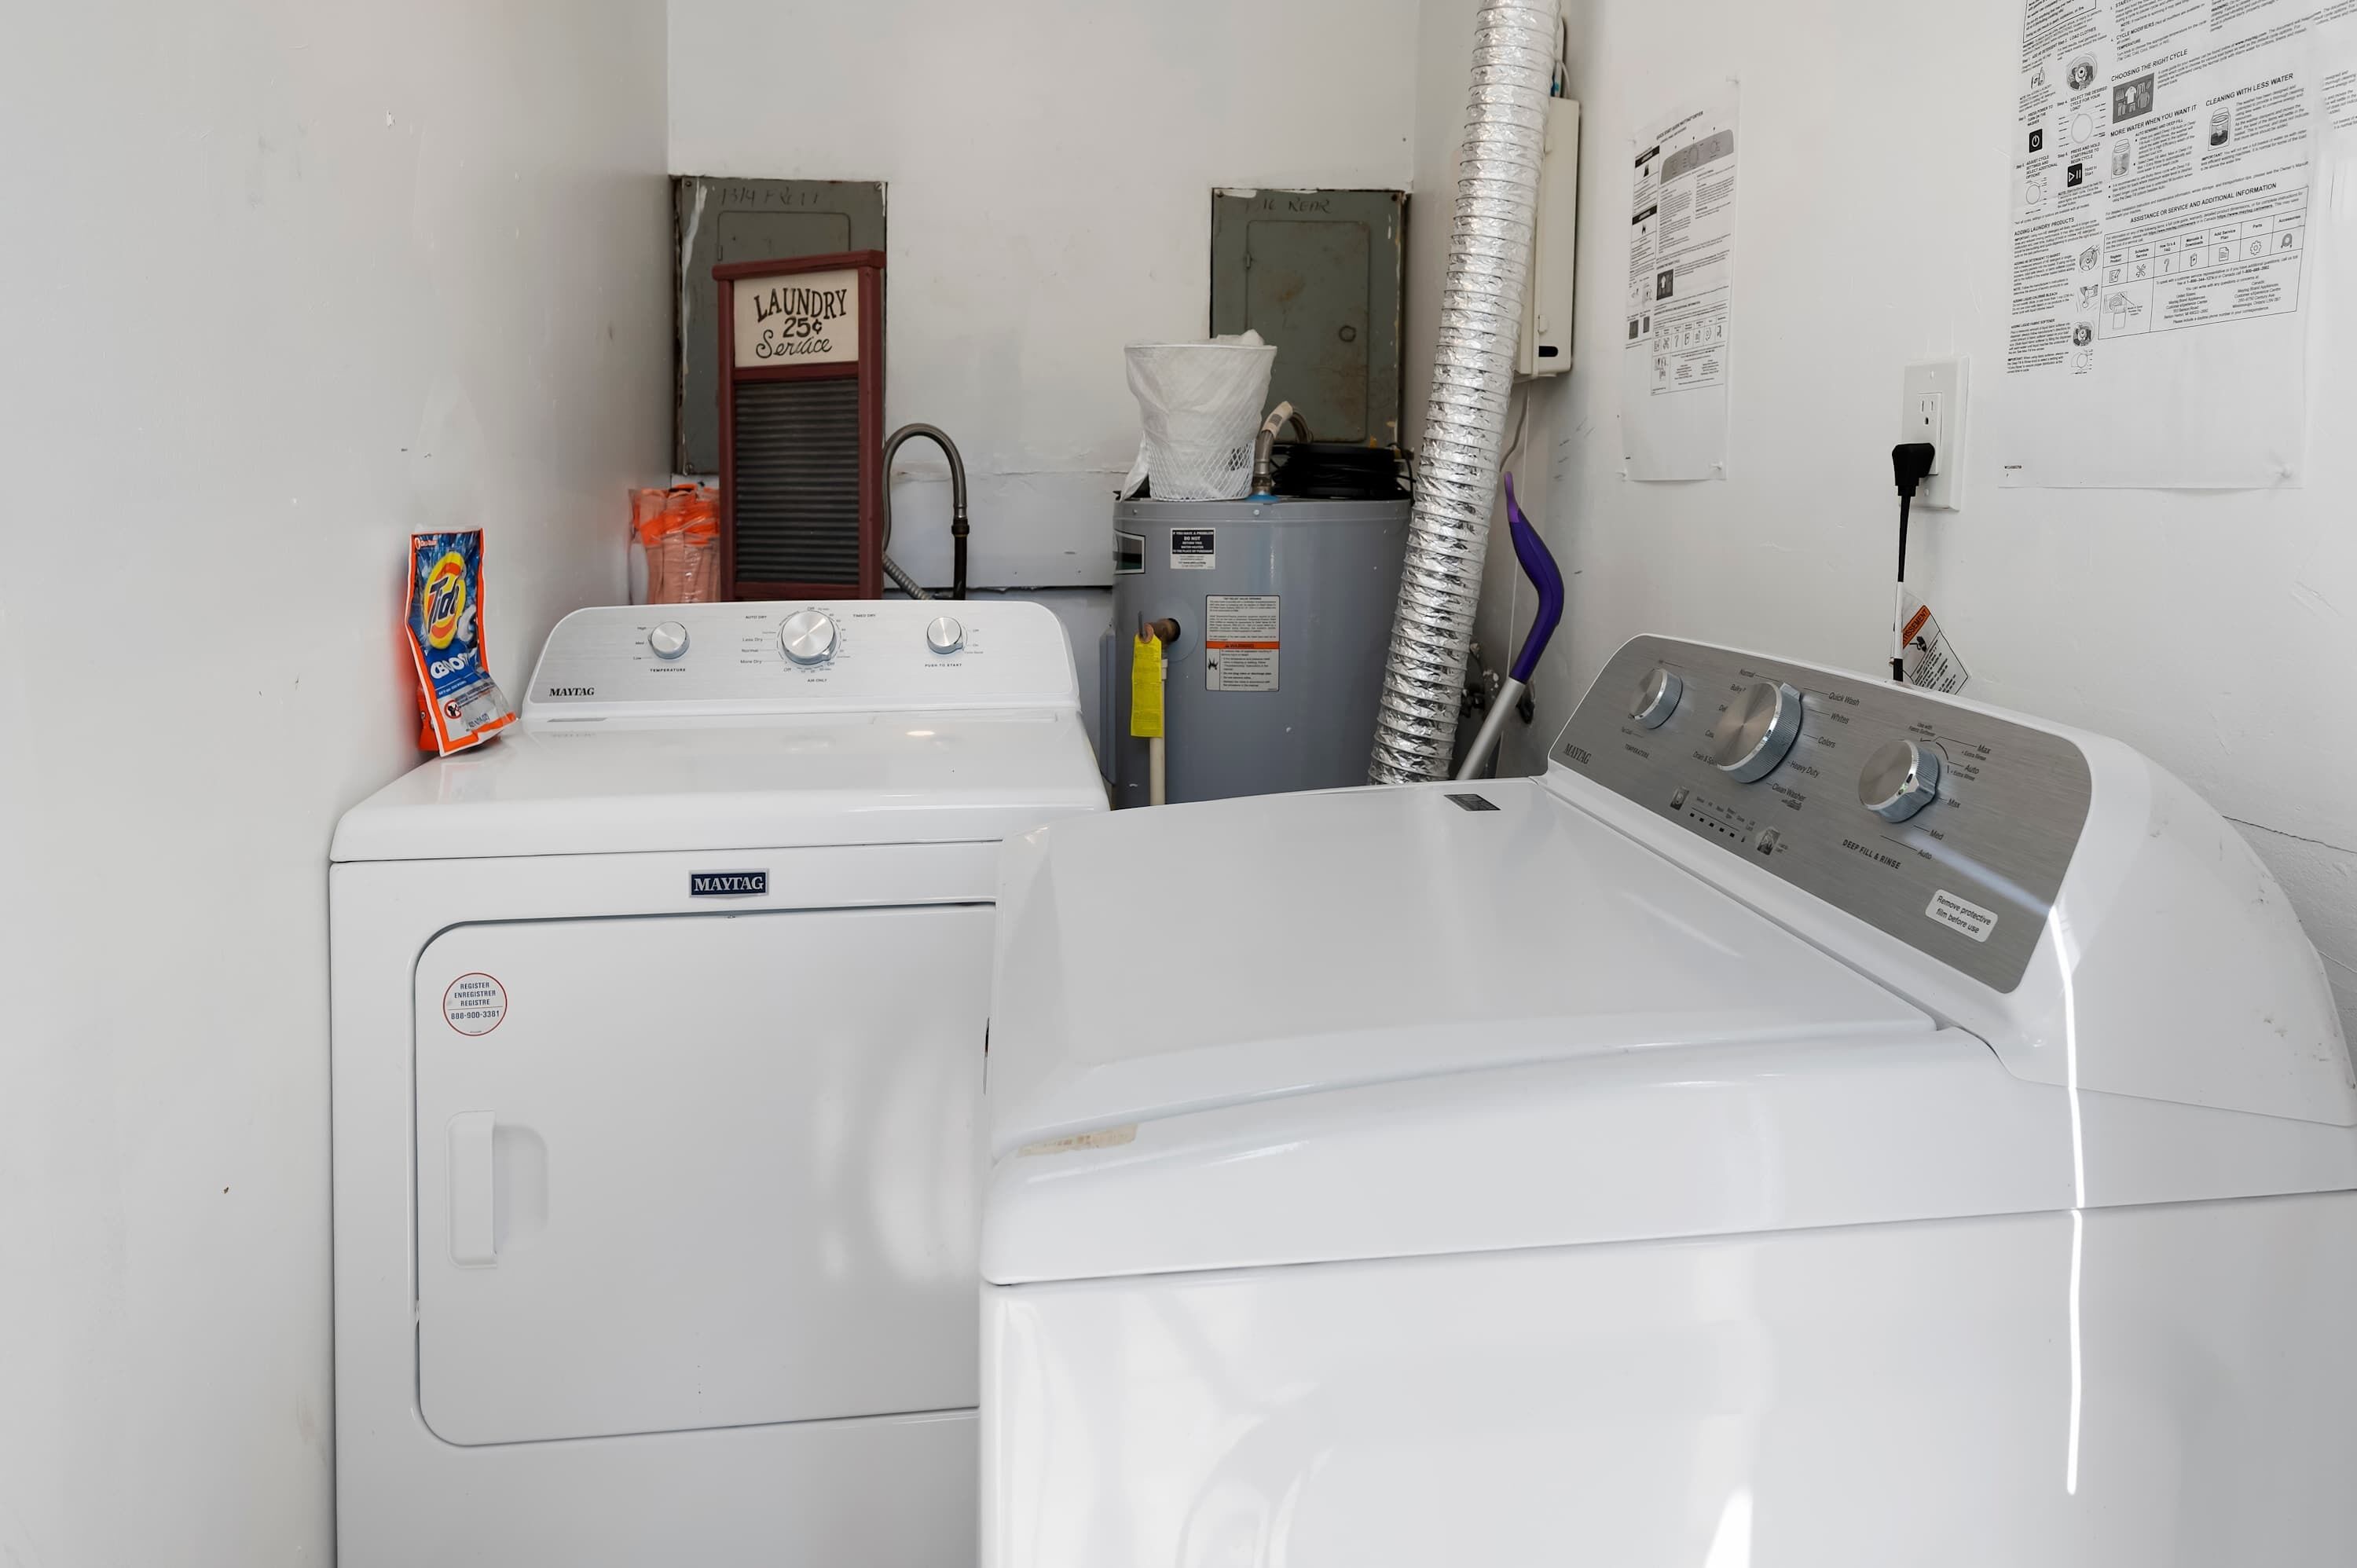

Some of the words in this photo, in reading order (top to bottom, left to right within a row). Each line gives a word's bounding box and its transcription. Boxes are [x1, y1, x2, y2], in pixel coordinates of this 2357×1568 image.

[2111, 67, 2140, 82] CHOOSING
[2141, 63, 2153, 71] THE
[2153, 56, 2169, 67] RIGHT
[2170, 49, 2188, 60] CYCLE
[2206, 92, 2235, 106] CLEANING
[2236, 87, 2252, 97] WITH
[2253, 81, 2269, 91] LESS
[2271, 73, 2294, 86] WATER
[2110, 128, 2126, 137] MORE
[2127, 121, 2144, 132] WATER
[2145, 116, 2161, 126] WHEN
[2161, 112, 2173, 120] YOU
[2174, 106, 2190, 117] WANT
[2131, 211, 2159, 223] ASSISTANCE
[2168, 203, 2188, 213] SERVICE
[2201, 193, 2234, 205] ADDITIONAL
[2236, 183, 2276, 197] INFORMATION
[754, 288, 847, 323] LAUNDRY
[783, 317, 822, 338] 25¢
[756, 329, 832, 359] Service
[549, 687, 595, 697] MAYTAG
[1829, 692, 1844, 702] Quick
[1844, 696, 1860, 706] Wash
[1831, 713, 1849, 724] Whites
[1818, 736, 1836, 748] Colors
[1977, 744, 1992, 754] Max
[1564, 743, 1592, 764] MAYTAG
[1790, 760, 1807, 773] Heavy
[1806, 766, 1820, 778] Duty
[1965, 764, 1979, 774] Auto
[1772, 782, 1787, 794] Clean
[1786, 788, 1806, 802] Washer
[1948, 798, 1961, 808] Max
[1930, 830, 1944, 840] Med
[1842, 839, 1860, 850] DEEP
[1860, 847, 1873, 858] FILL
[1880, 855, 1901, 869] RINSE
[1918, 849, 1932, 860] Auto
[694, 877, 764, 891] MAYTAG
[1937, 895, 1961, 911] Remove
[1960, 908, 1991, 925] protective
[1936, 908, 1947, 918] film
[1948, 914, 1968, 927] before
[1968, 924, 1980, 933] use
[455, 990, 496, 998] ENREGISTRER
